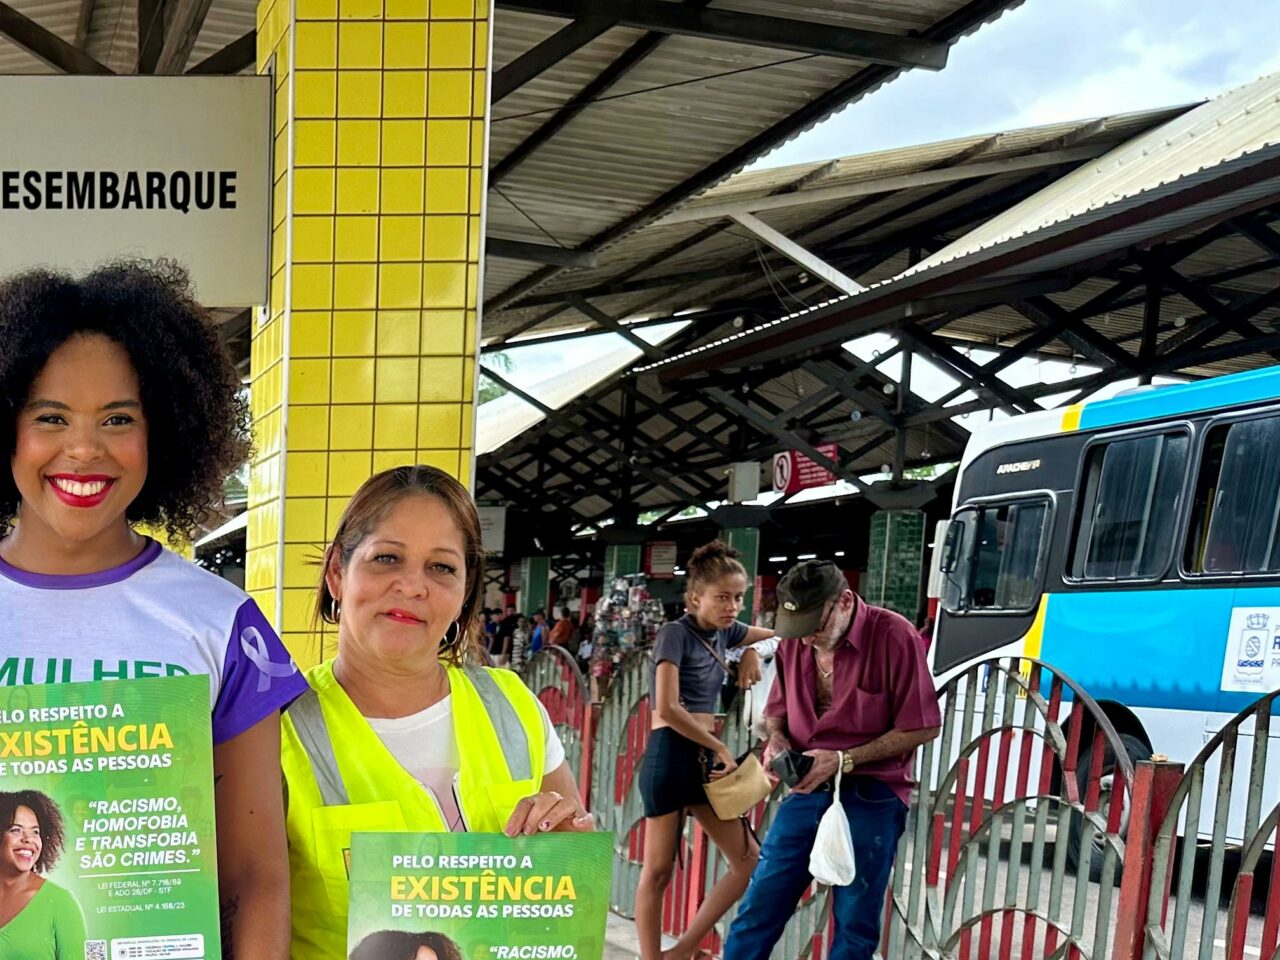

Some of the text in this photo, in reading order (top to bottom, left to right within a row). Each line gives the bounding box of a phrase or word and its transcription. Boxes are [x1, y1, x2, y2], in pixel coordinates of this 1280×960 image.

[29, 704, 107, 722] RESPEITO
[112, 703, 124, 718] A
[10, 758, 68, 775] TODAS
[72, 757, 93, 772] AS
[97, 753, 171, 771] PESSOAS
[89, 797, 181, 815] “RACISMO,
[83, 814, 188, 833] HOMOFOBIA
[75, 832, 198, 851] E TRANSFOBIA
[80, 849, 200, 869] SÃO CRIMES.”
[393, 855, 533, 868] PELO RESPEITO A
[110, 881, 140, 889] FEDERAL
[390, 869, 577, 900] EXISTÊNCIA
[108, 904, 143, 913] ESTADUAL
[391, 904, 574, 918] DE TODAS AS PESSOAS
[489, 945, 577, 960] “RACISMO,
